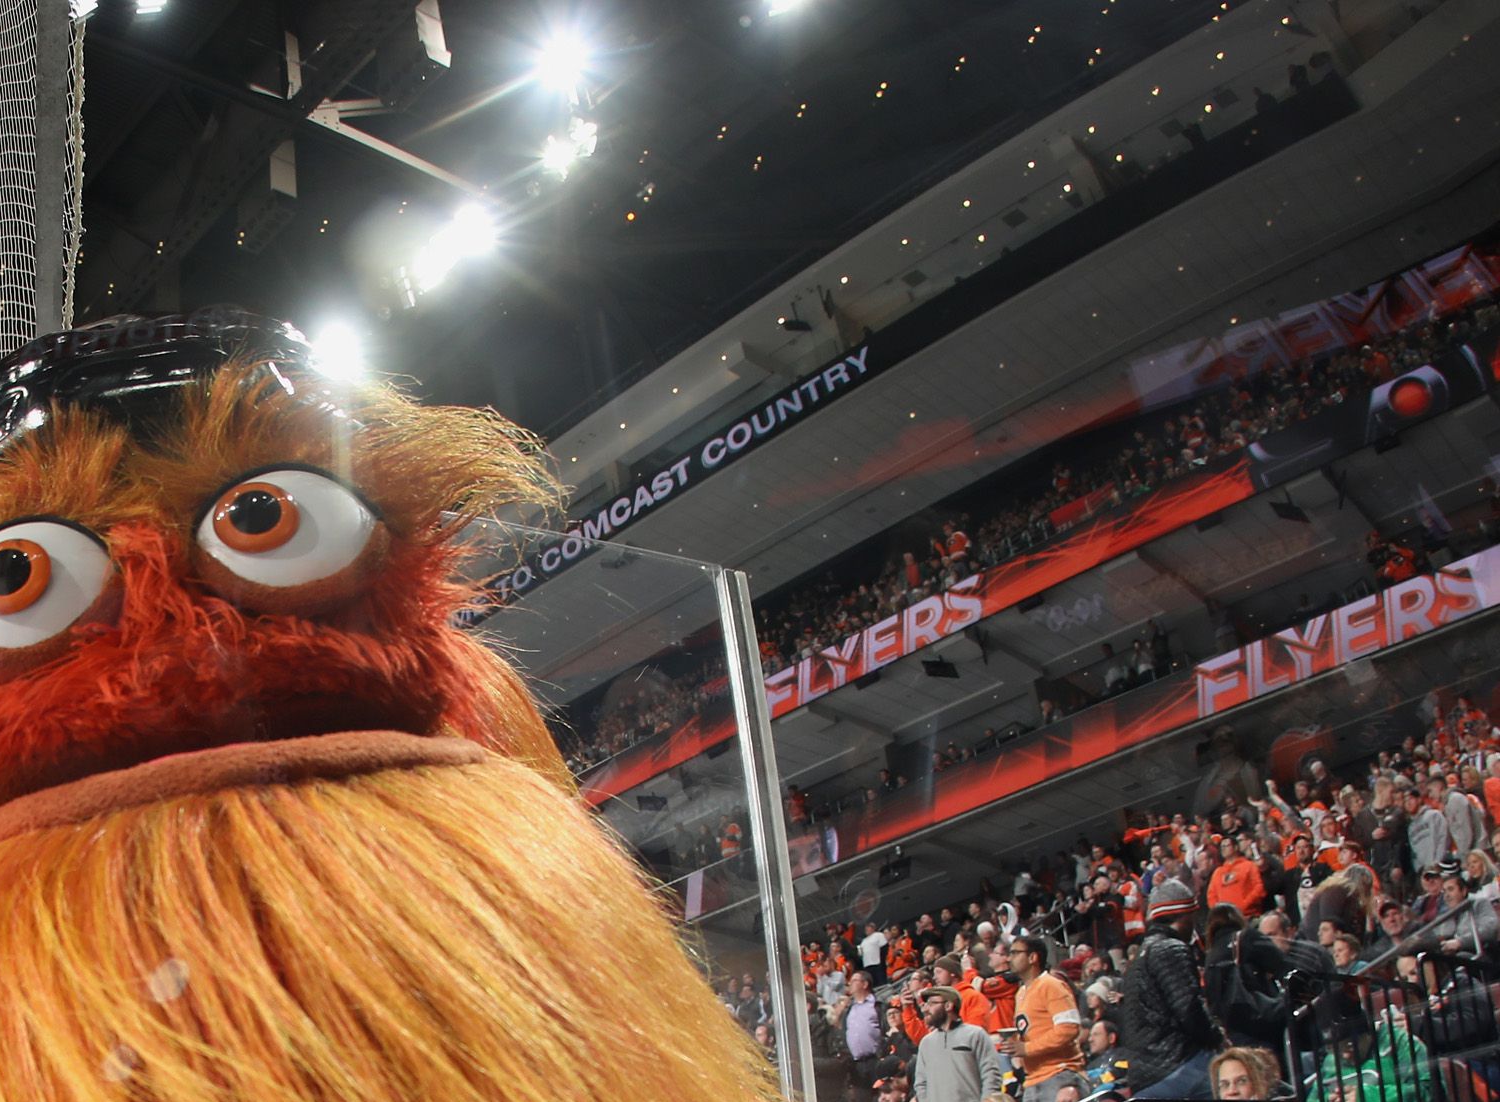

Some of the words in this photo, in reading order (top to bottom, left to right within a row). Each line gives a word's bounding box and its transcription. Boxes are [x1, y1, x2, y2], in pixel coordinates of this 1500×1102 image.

[496, 564, 533, 600] TO
[540, 456, 693, 573] COMCAST
[701, 345, 870, 470] COUNTRY
[764, 574, 985, 719] FLYERS
[1198, 568, 1480, 717] FLYERS
